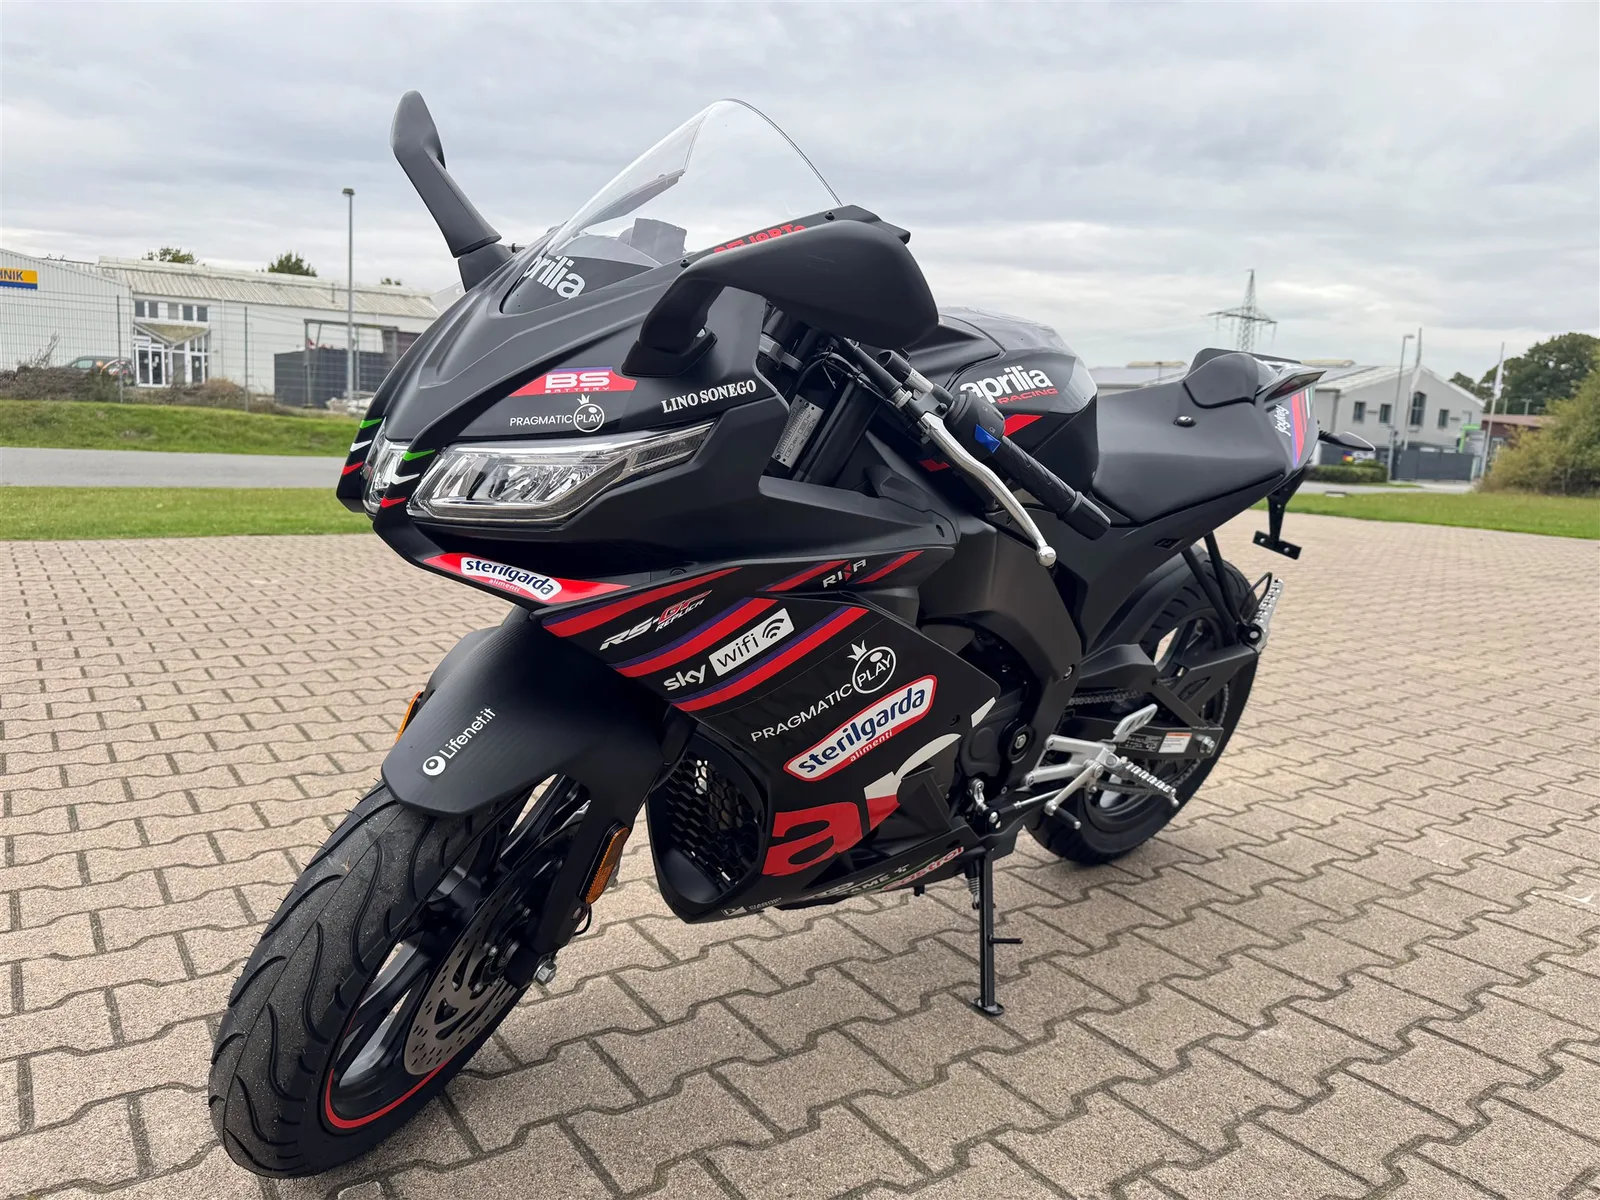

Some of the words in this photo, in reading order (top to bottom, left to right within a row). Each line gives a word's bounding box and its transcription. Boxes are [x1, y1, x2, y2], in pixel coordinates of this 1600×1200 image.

[519, 256, 586, 299] prilia
[545, 372, 610, 388] BS
[661, 393, 698, 413] LINO
[699, 380, 757, 404] SONEGO
[997, 388, 1059, 404] RACING
[509, 414, 573, 426] PRAGMATIC
[576, 414, 602, 423] PLAY
[466, 560, 554, 595] sterilgarda
[489, 578, 521, 593] alimenti
[663, 664, 706, 691] sky
[716, 633, 759, 668] wifi
[750, 683, 853, 742] PRAGMATIC
[856, 654, 891, 688] PLAY
[439, 708, 496, 759] Lifenet.it
[798, 687, 926, 773] sterilgarda
[850, 729, 894, 762] alimenti
